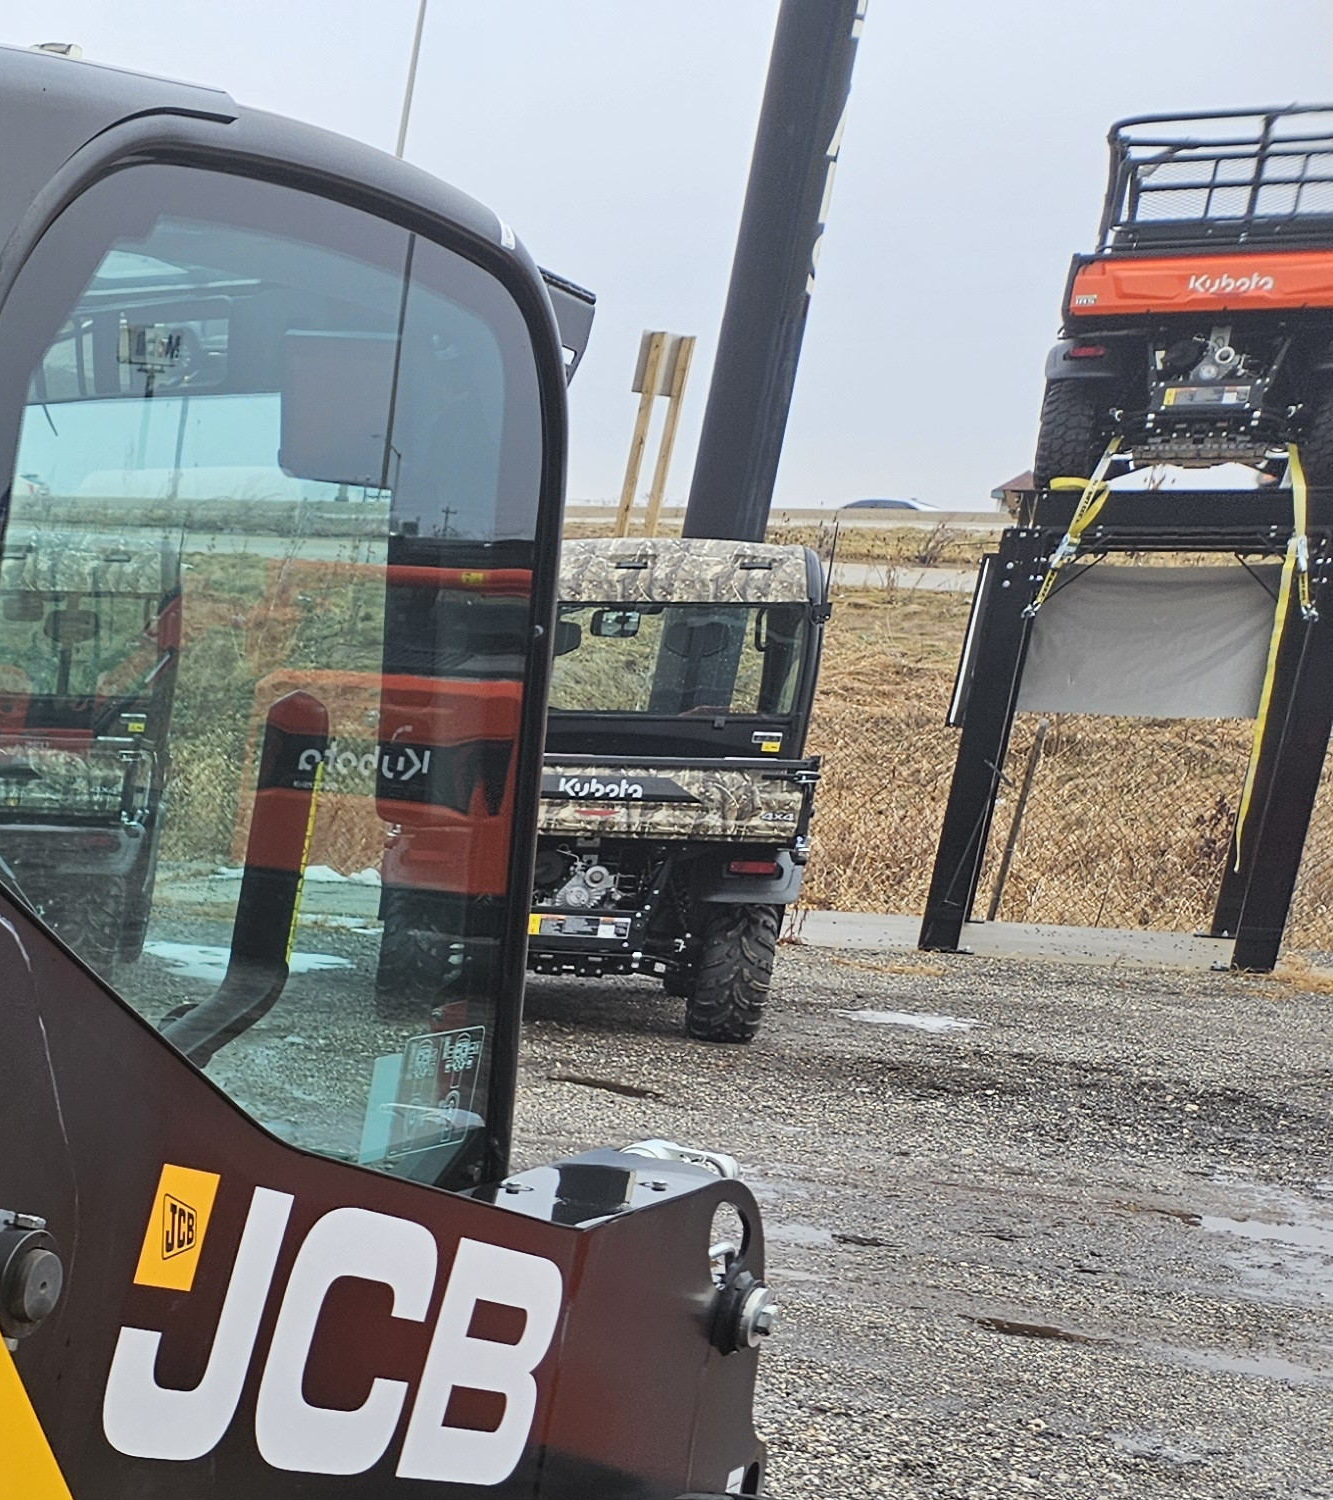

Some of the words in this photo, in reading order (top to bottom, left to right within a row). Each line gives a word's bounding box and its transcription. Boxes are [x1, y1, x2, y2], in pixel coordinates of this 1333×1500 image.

[1188, 272, 1274, 294] Kubota
[558, 777, 643, 798] Kubota
[761, 812, 794, 822] 4x4
[165, 1203, 197, 1253] JCB
[103, 1186, 563, 1486] JCB
